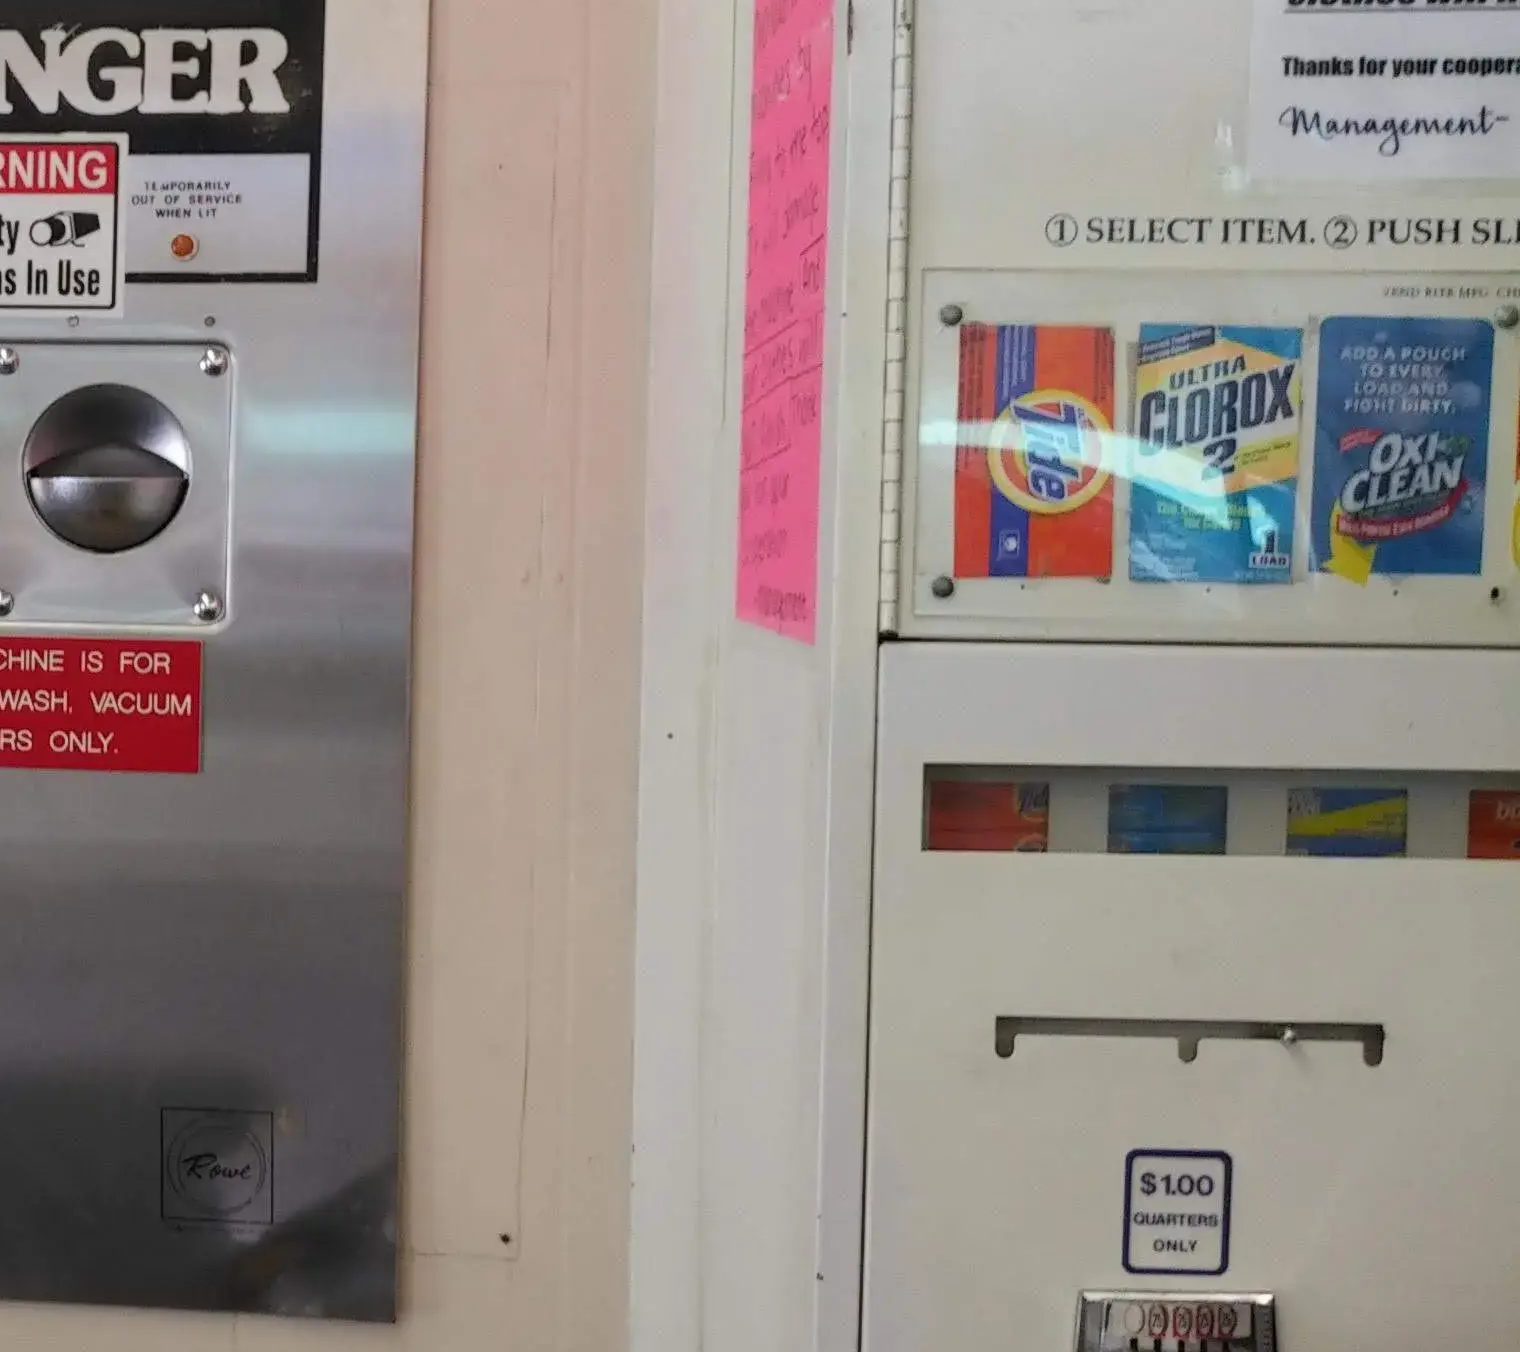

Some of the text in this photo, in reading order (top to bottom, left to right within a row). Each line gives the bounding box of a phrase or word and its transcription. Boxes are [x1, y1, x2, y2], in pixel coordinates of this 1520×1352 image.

[1283, 56, 1354, 77] Thanks
[1358, 56, 1388, 77] for
[1392, 57, 1438, 79] your
[131, 194, 156, 206] OUT
[1086, 216, 1213, 245] SELECT
[1221, 217, 1316, 245] ITEM.
[1368, 218, 1463, 246] PUSH
[28, 259, 48, 295] In
[58, 259, 101, 296] Use
[1170, 354, 1246, 390] ULTRA
[1138, 364, 1296, 456] CLOROX
[1201, 438, 1237, 481] 2
[81, 650, 103, 673] IS
[119, 650, 171, 675] FOR
[90, 691, 193, 717] VACUUM
[49, 730, 119, 755] ONLY.
[1139, 1172, 1215, 1197] $1.00
[1133, 1211, 1219, 1228] QUARTERS
[1152, 1239, 1198, 1253] ONLY
